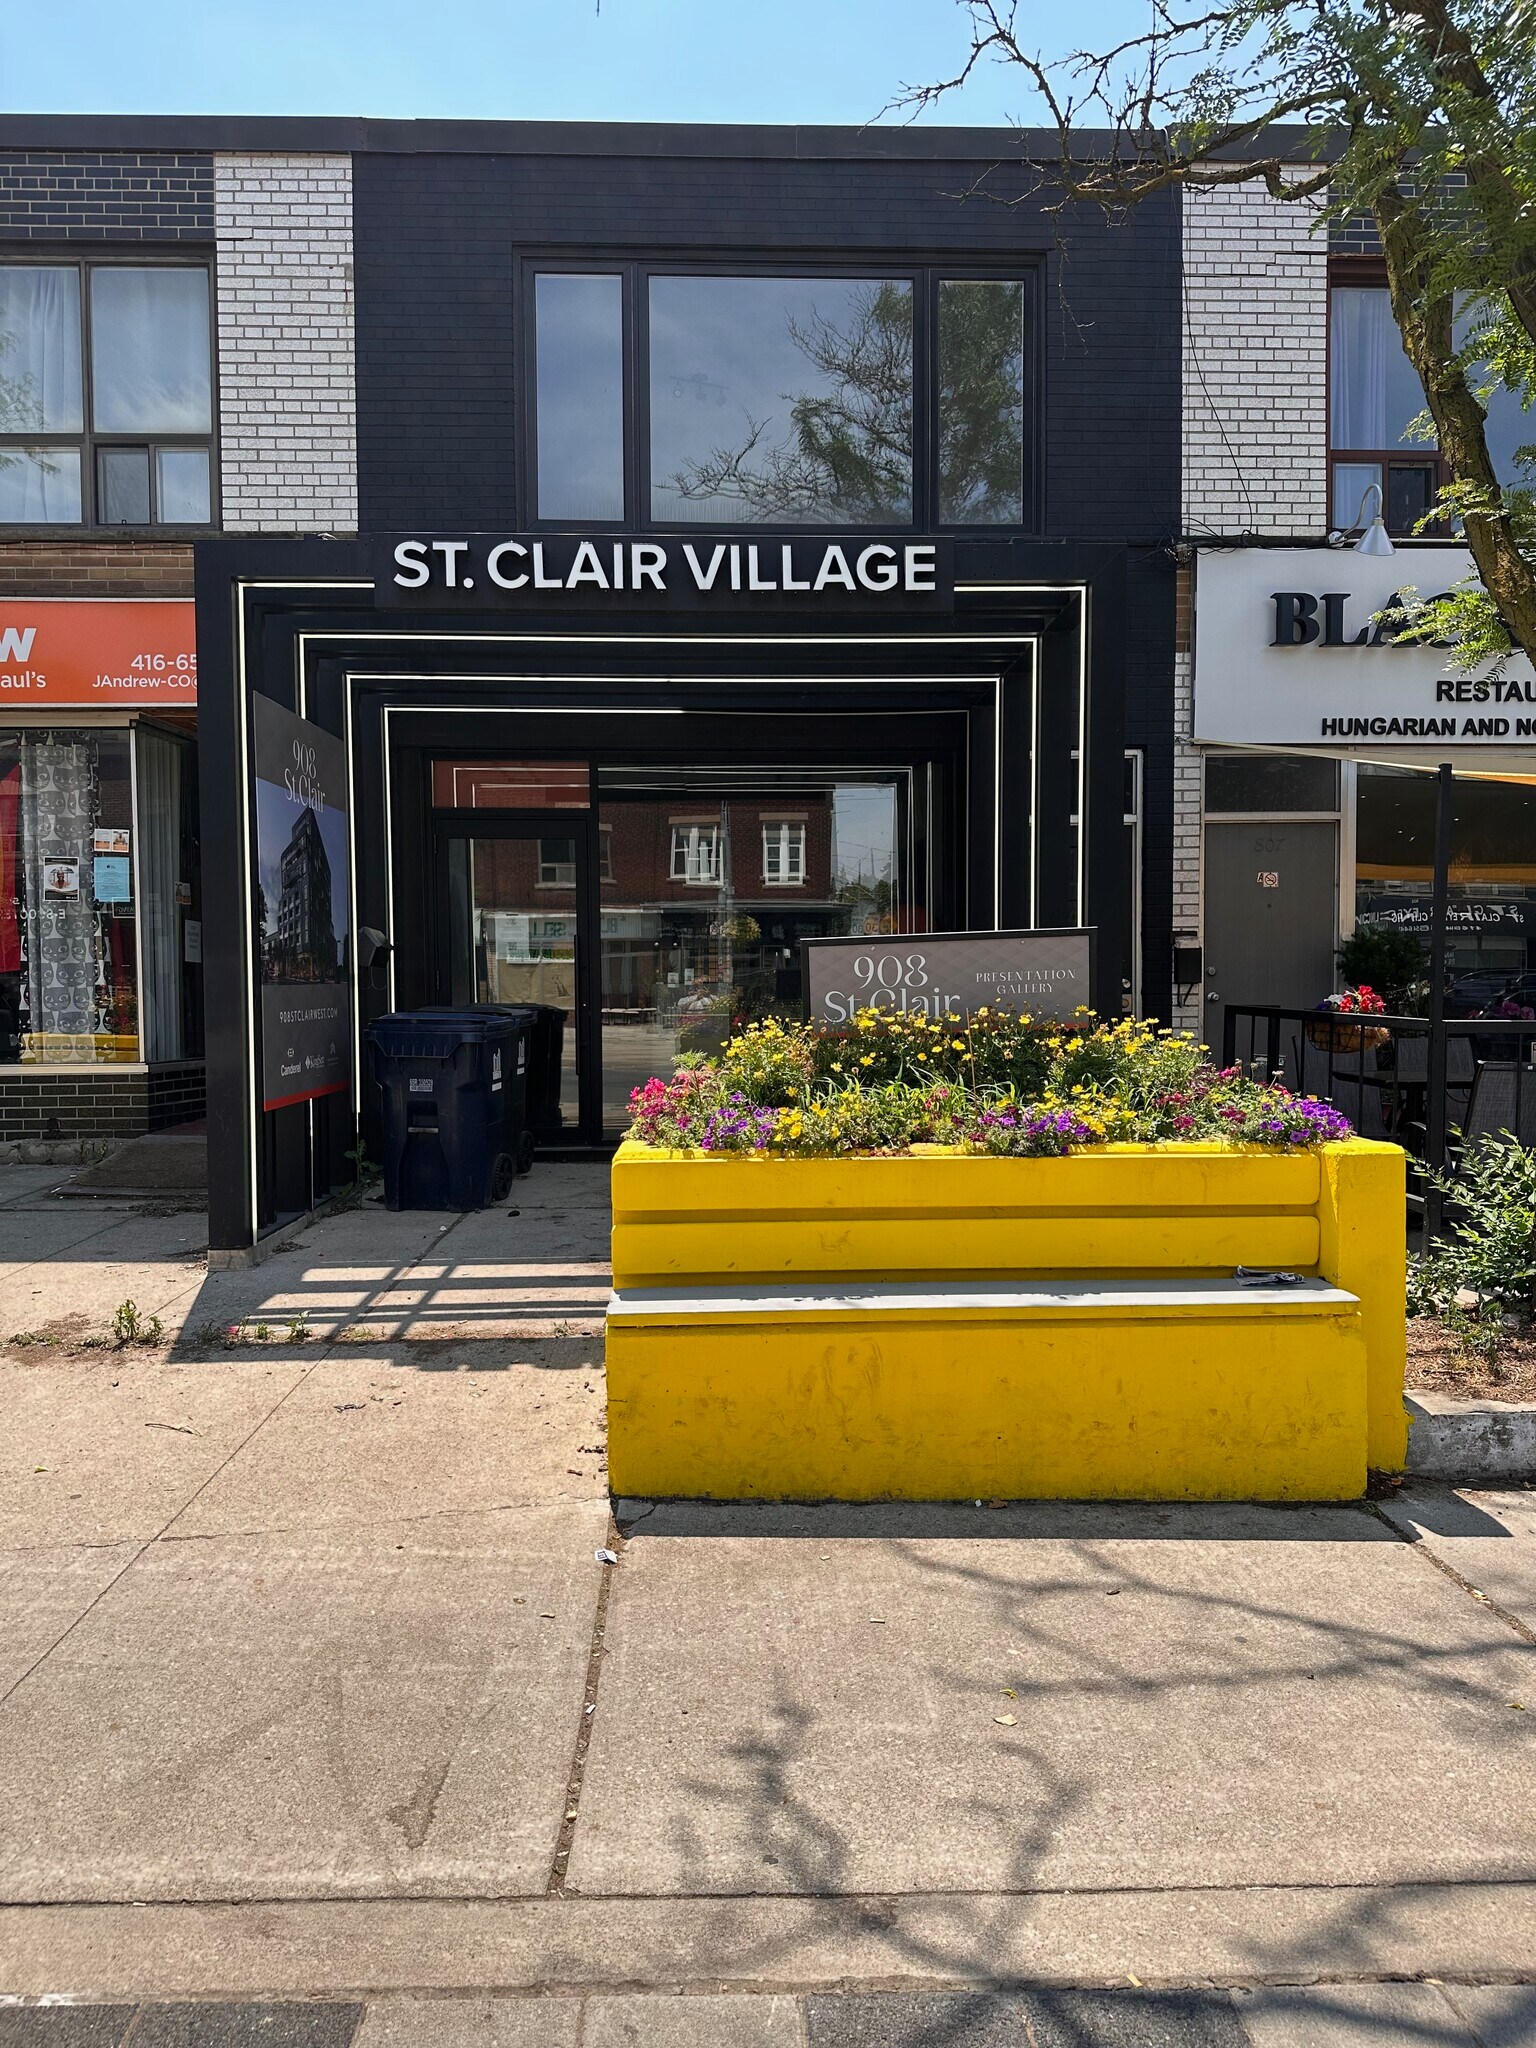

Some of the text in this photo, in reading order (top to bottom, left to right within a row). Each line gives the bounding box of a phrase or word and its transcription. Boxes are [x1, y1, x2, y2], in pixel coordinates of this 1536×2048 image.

[393, 541, 936, 591] ST. CLAIR VILLAGE
[1269, 592, 1524, 648] BLAC
[1321, 717, 1536, 736] HUNGARIAN AND N
[293, 739, 317, 779] 908
[853, 954, 928, 989] 908
[976, 969, 1076, 983] PRESENTATION
[996, 983, 1054, 995] GALLERY
